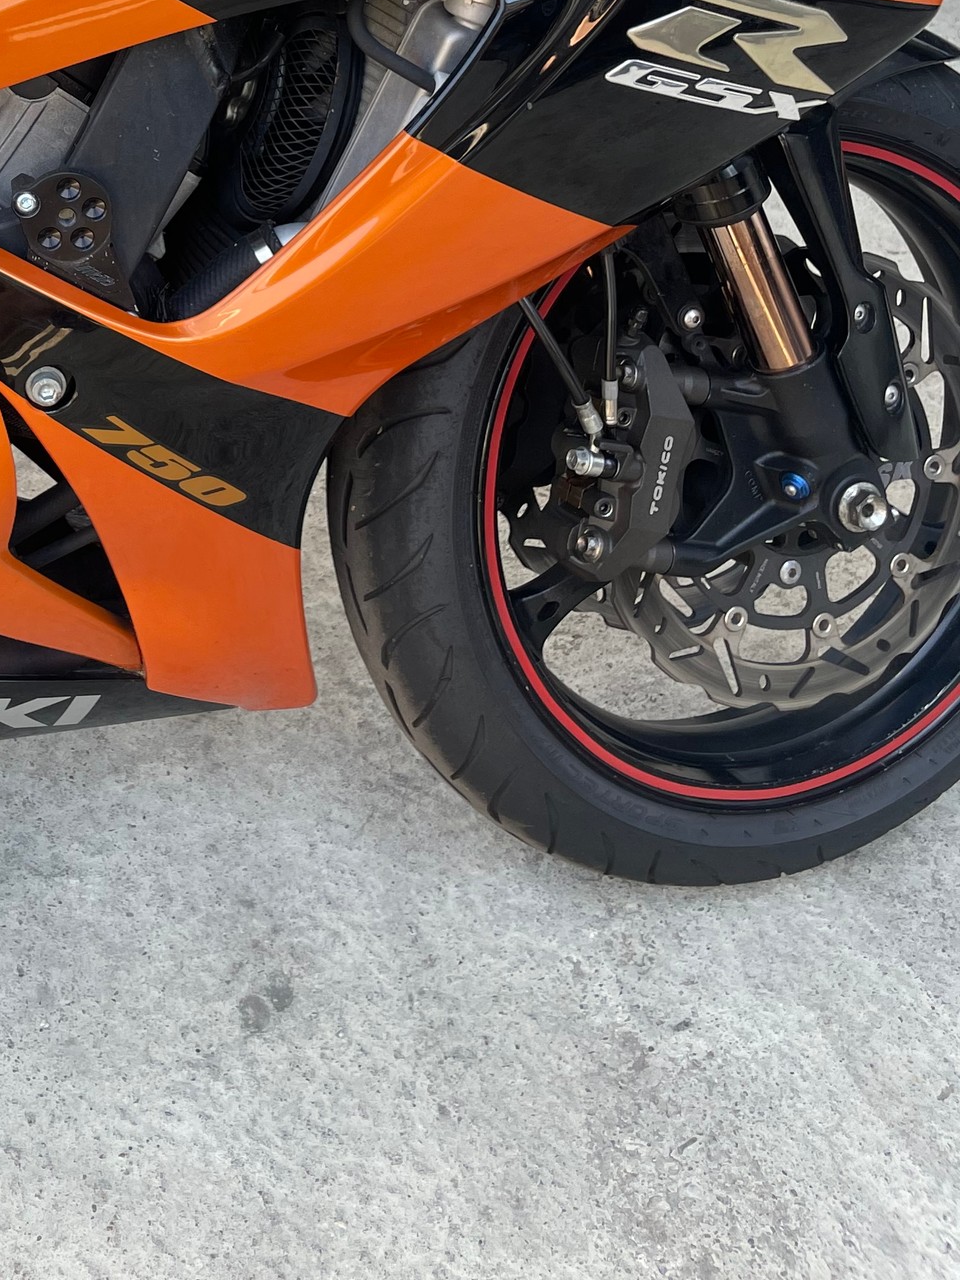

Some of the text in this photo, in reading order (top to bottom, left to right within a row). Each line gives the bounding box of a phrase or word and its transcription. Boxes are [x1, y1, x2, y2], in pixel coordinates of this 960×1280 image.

[604, 59, 828, 121] GSX
[81, 415, 248, 507] 750
[649, 436, 674, 515] TOKICO
